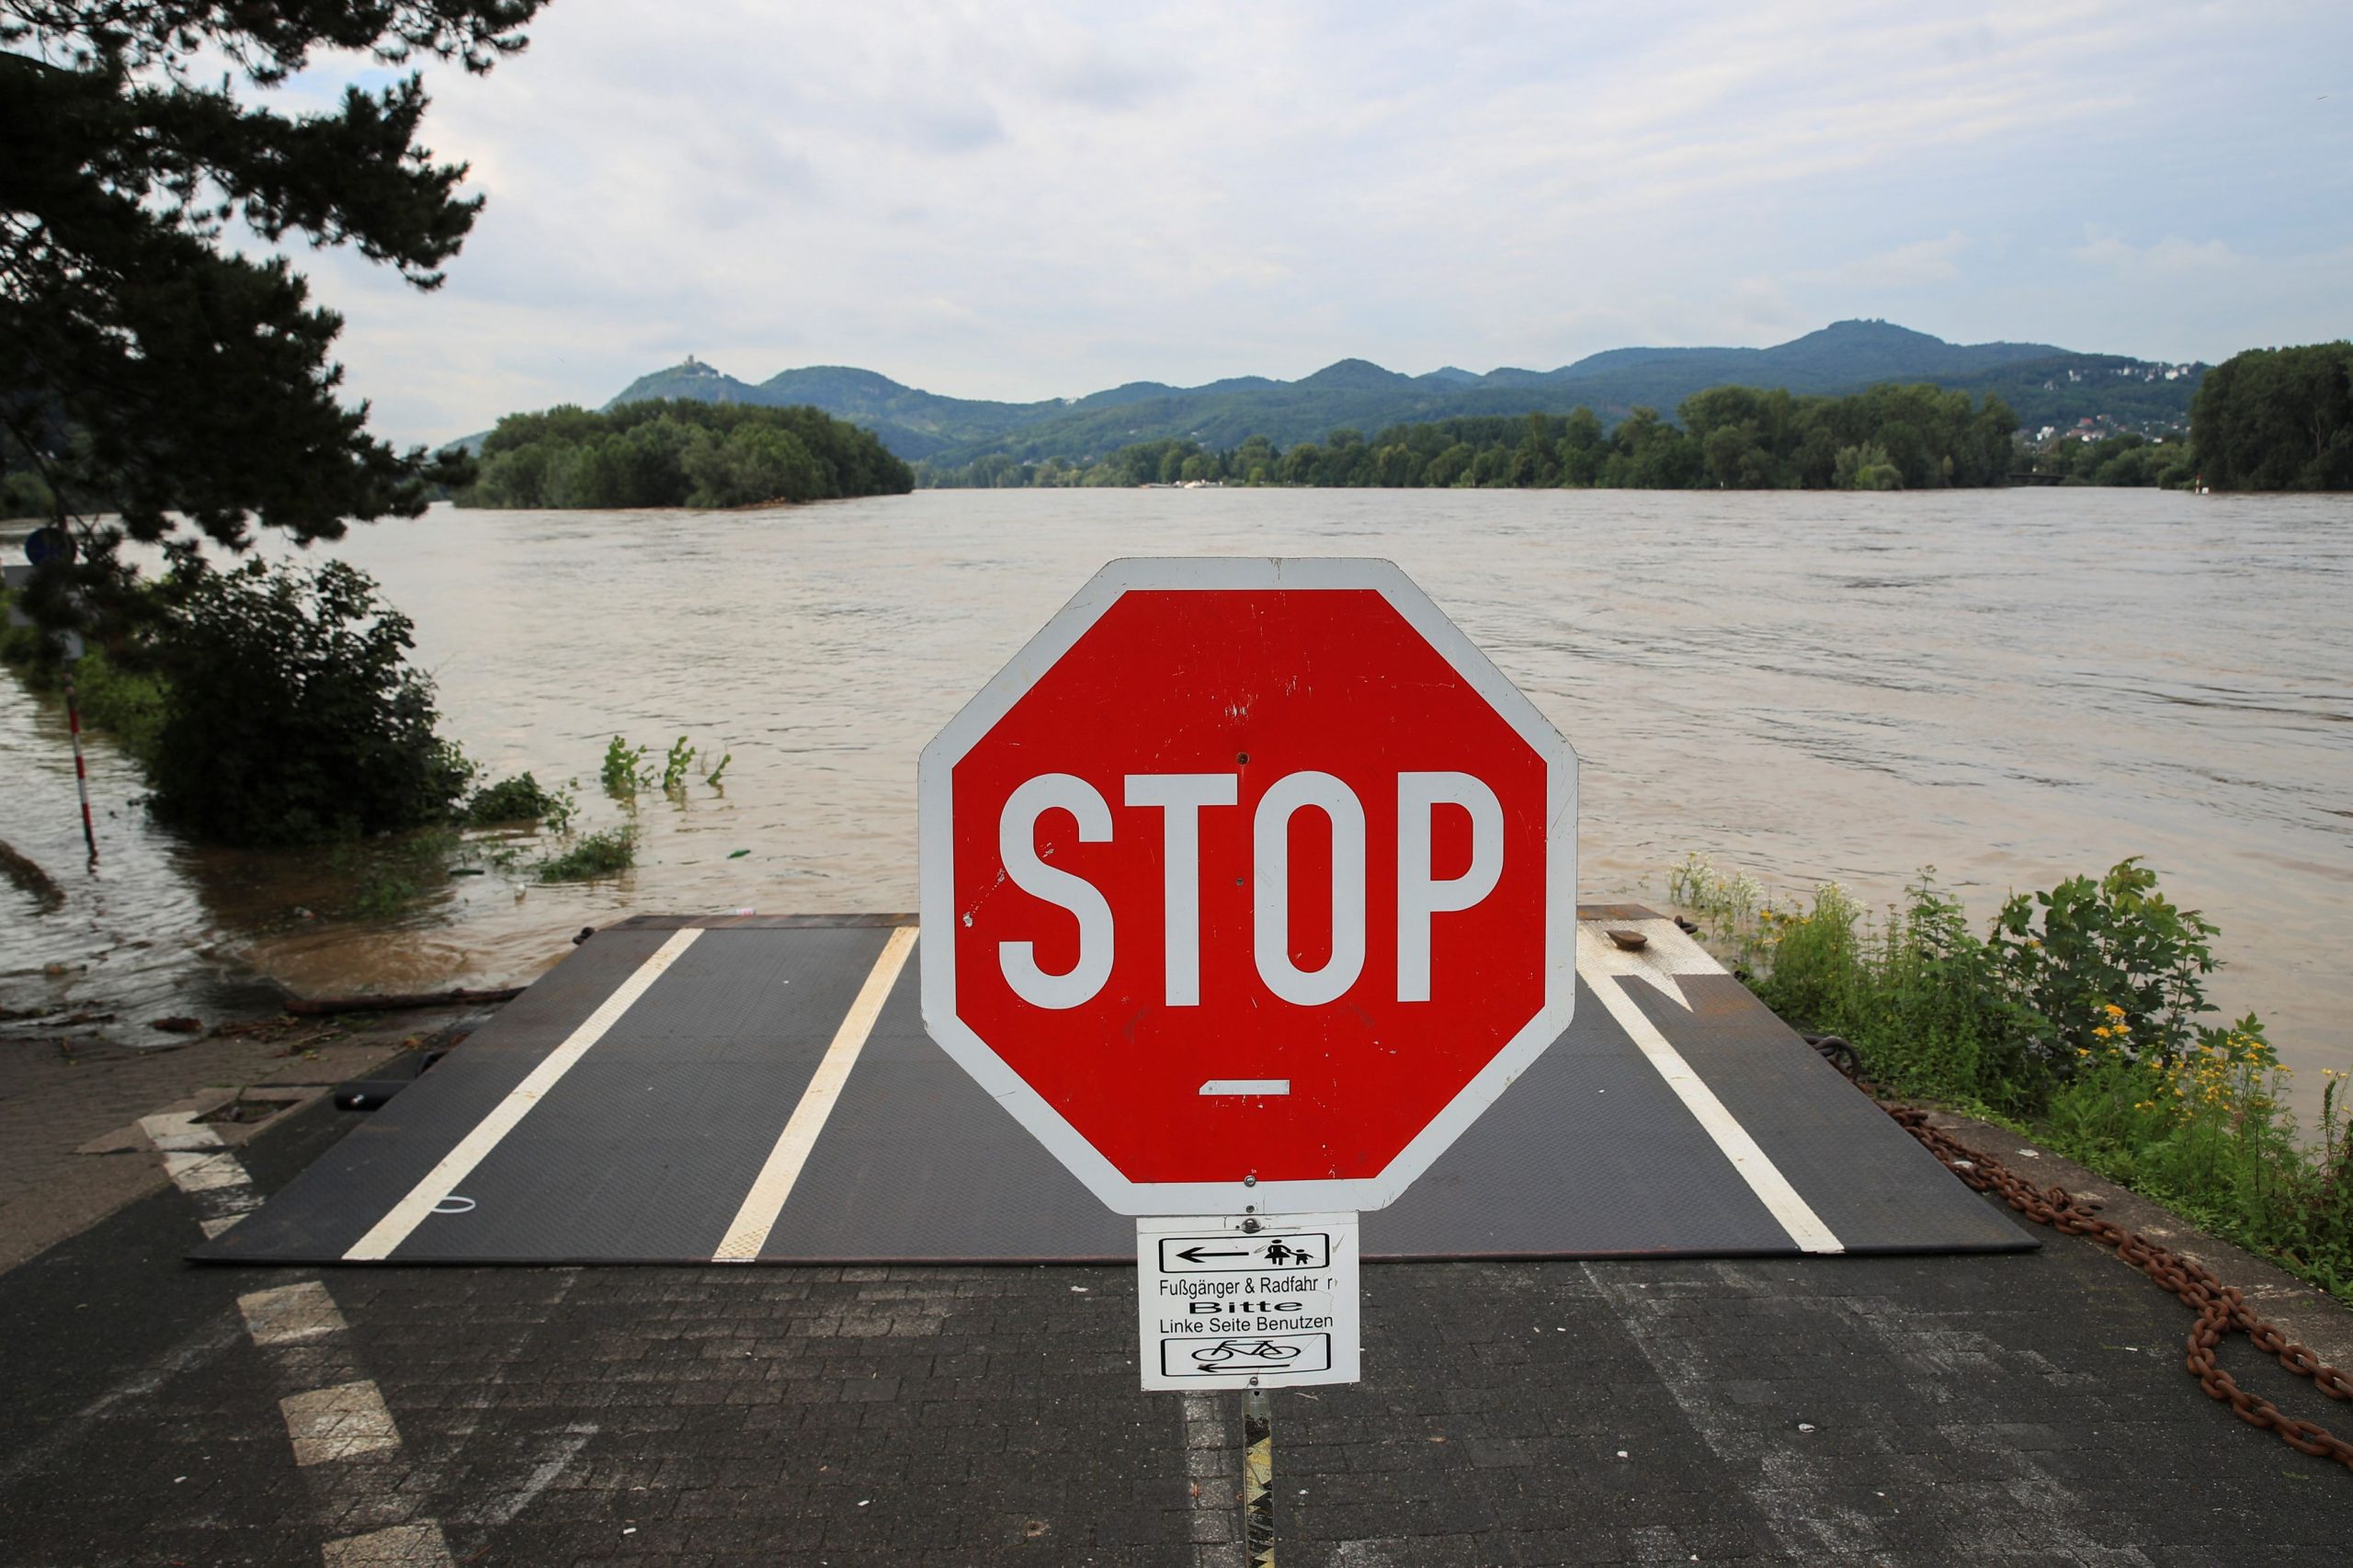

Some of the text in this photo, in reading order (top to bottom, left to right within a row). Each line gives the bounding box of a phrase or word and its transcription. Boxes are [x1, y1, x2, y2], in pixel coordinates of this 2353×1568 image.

[999, 770, 1505, 1010] STOP
[1160, 1276, 1333, 1299] Fußgänger & Radfahrr
[1189, 1301, 1303, 1314] Bitte
[1160, 1314, 1334, 1333] Linke Seite Benutzen
